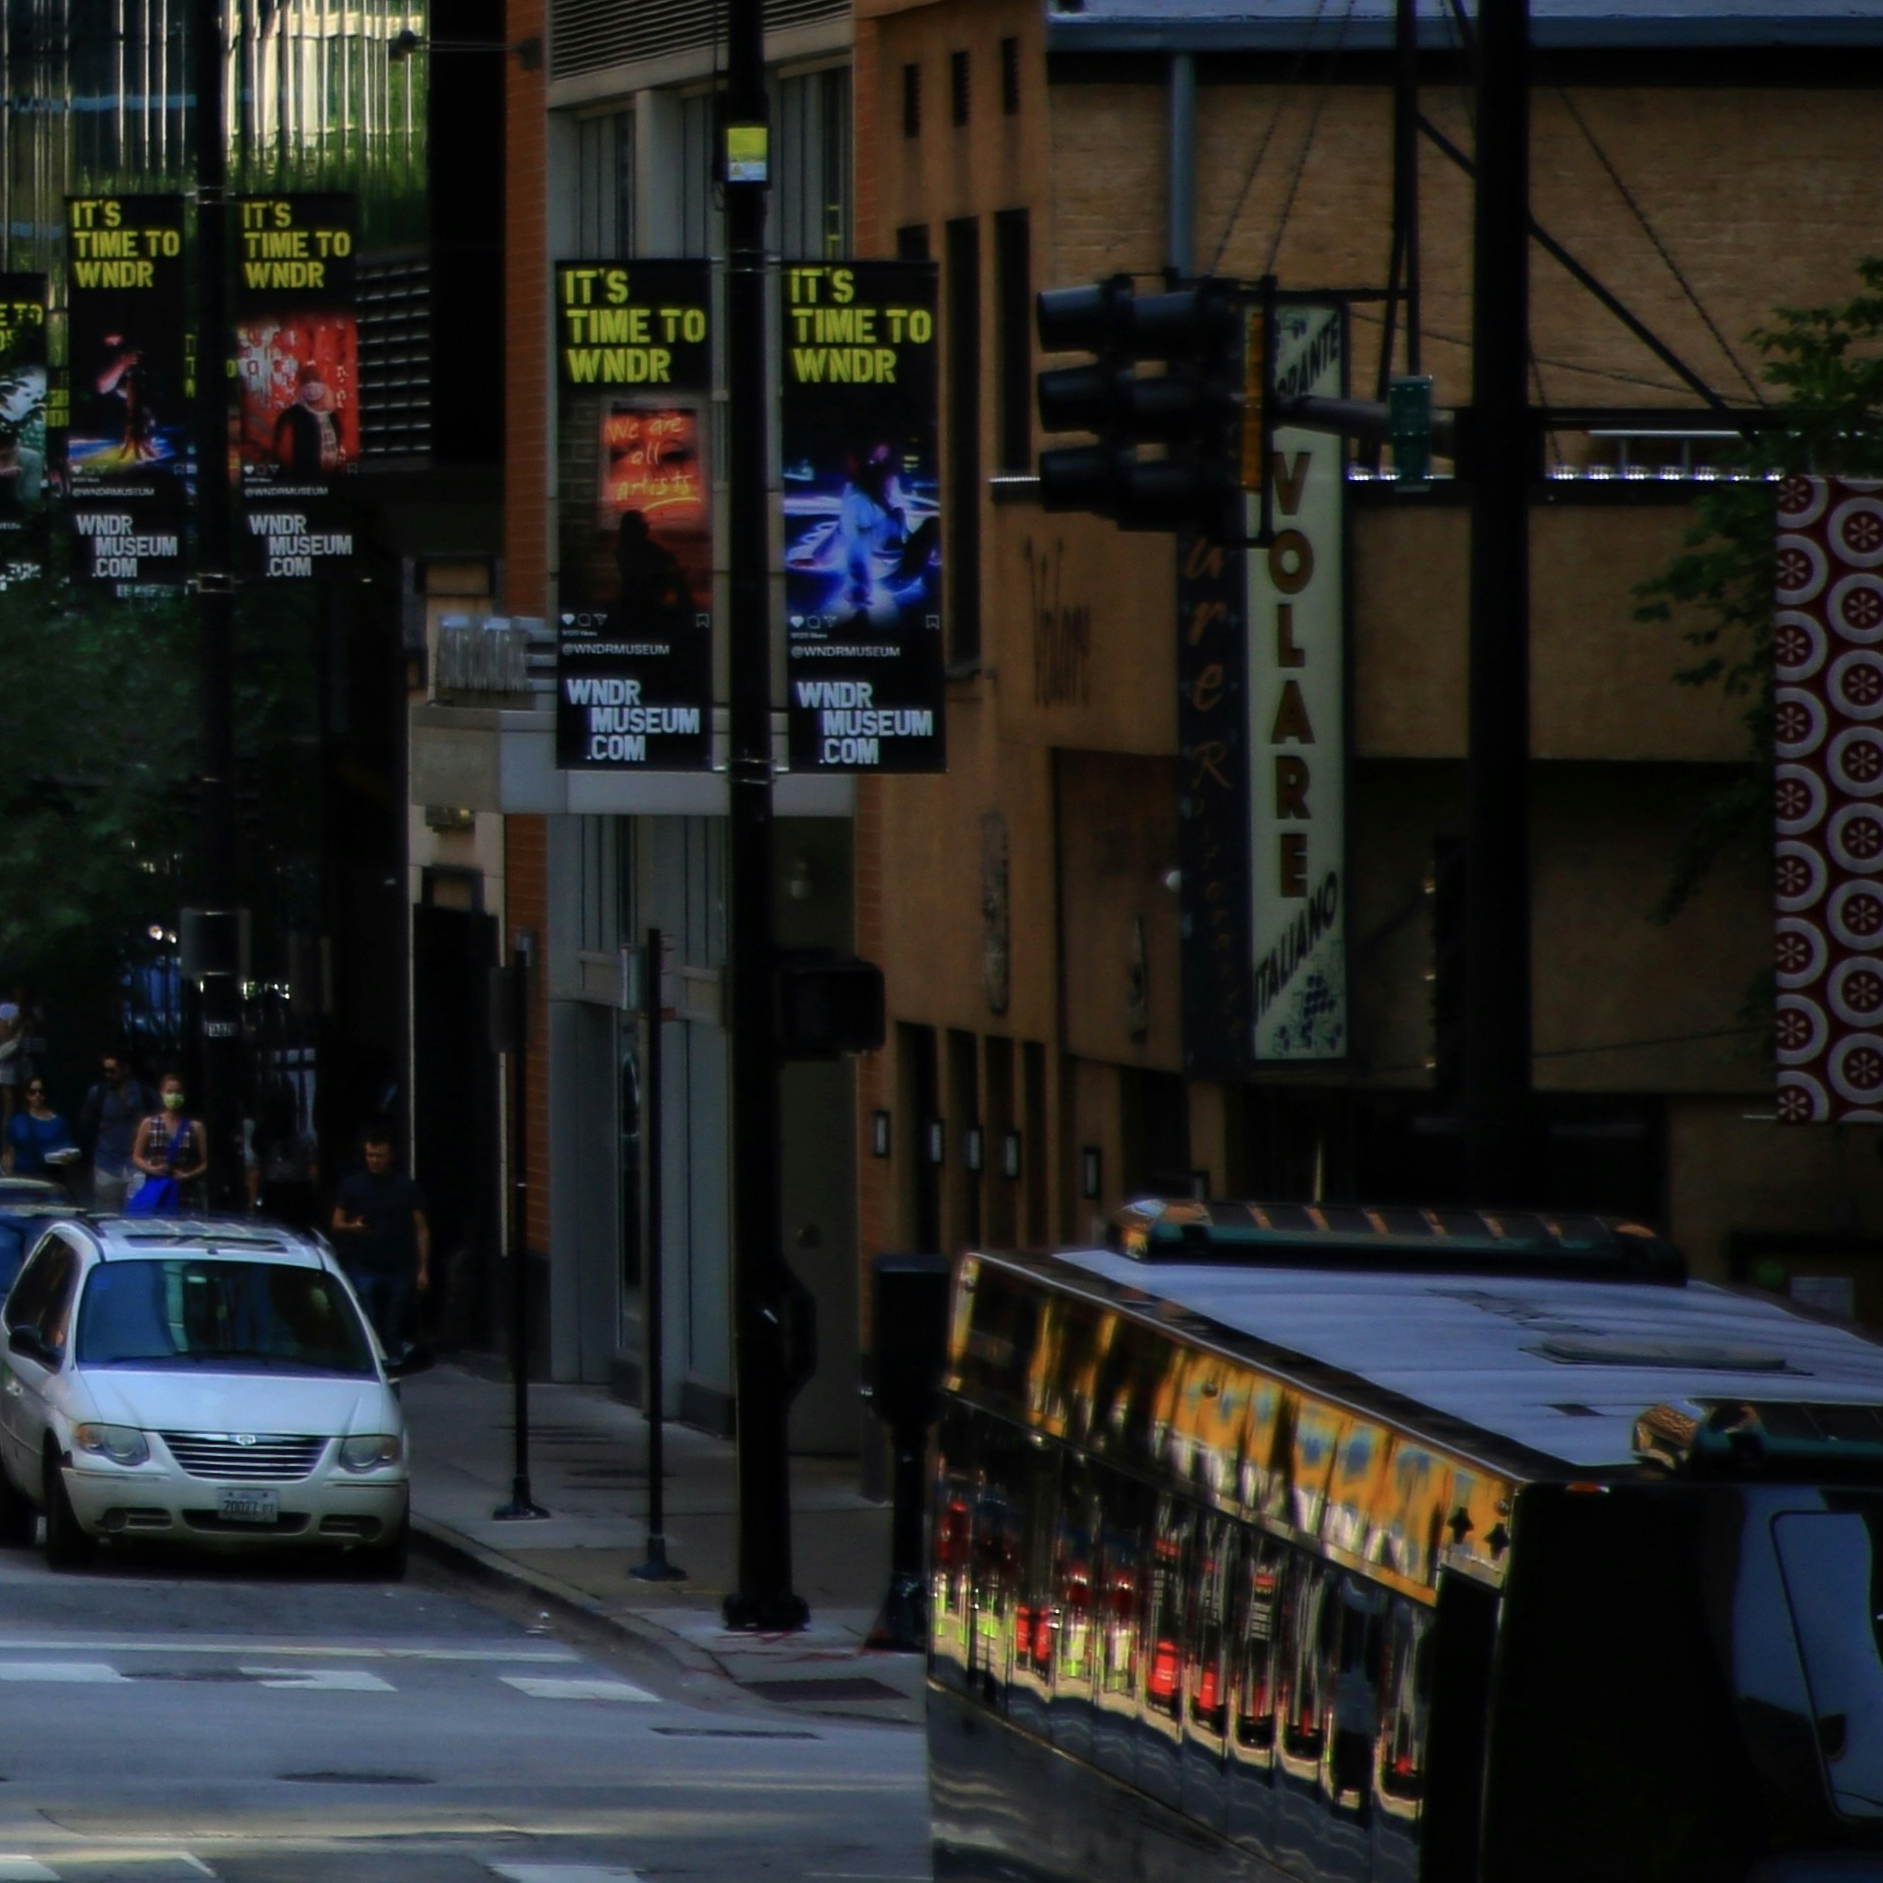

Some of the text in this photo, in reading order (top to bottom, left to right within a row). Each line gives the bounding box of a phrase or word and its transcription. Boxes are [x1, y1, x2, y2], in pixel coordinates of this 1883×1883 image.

[72, 201, 122, 228] IT'S
[241, 202, 292, 229] IT'S
[73, 230, 181, 258] TIME TO
[243, 231, 352, 258] TIME TO
[74, 261, 154, 288] WNDR
[244, 262, 325, 289] WNDR
[563, 267, 630, 305] IT'S
[788, 267, 855, 304] IT'S
[565, 309, 707, 344] TIME TO
[790, 308, 932, 344] TIME TO
[565, 348, 672, 383] WNDR
[790, 348, 897, 383] WNDR
[76, 515, 134, 536] WNDR
[248, 514, 308, 535] WNDR
[95, 536, 178, 557] MUSEUM
[269, 535, 353, 556] MUSEUM
[91, 557, 138, 578] .COM
[265, 557, 312, 578] .COM
[562, 643, 670, 656] @WNDRMUSEUM
[790, 645, 901, 659] @WNDRMUSEUM
[1268, 452, 1315, 898] VOLARE
[565, 679, 642, 706] WNDR
[796, 681, 873, 709] WNDR
[591, 707, 701, 735] MUSEUM
[822, 710, 934, 737] MUSEUM
[586, 734, 646, 762] .COM
[818, 738, 879, 766] .COM
[1255, 872, 1338, 1013] ITALIANO
